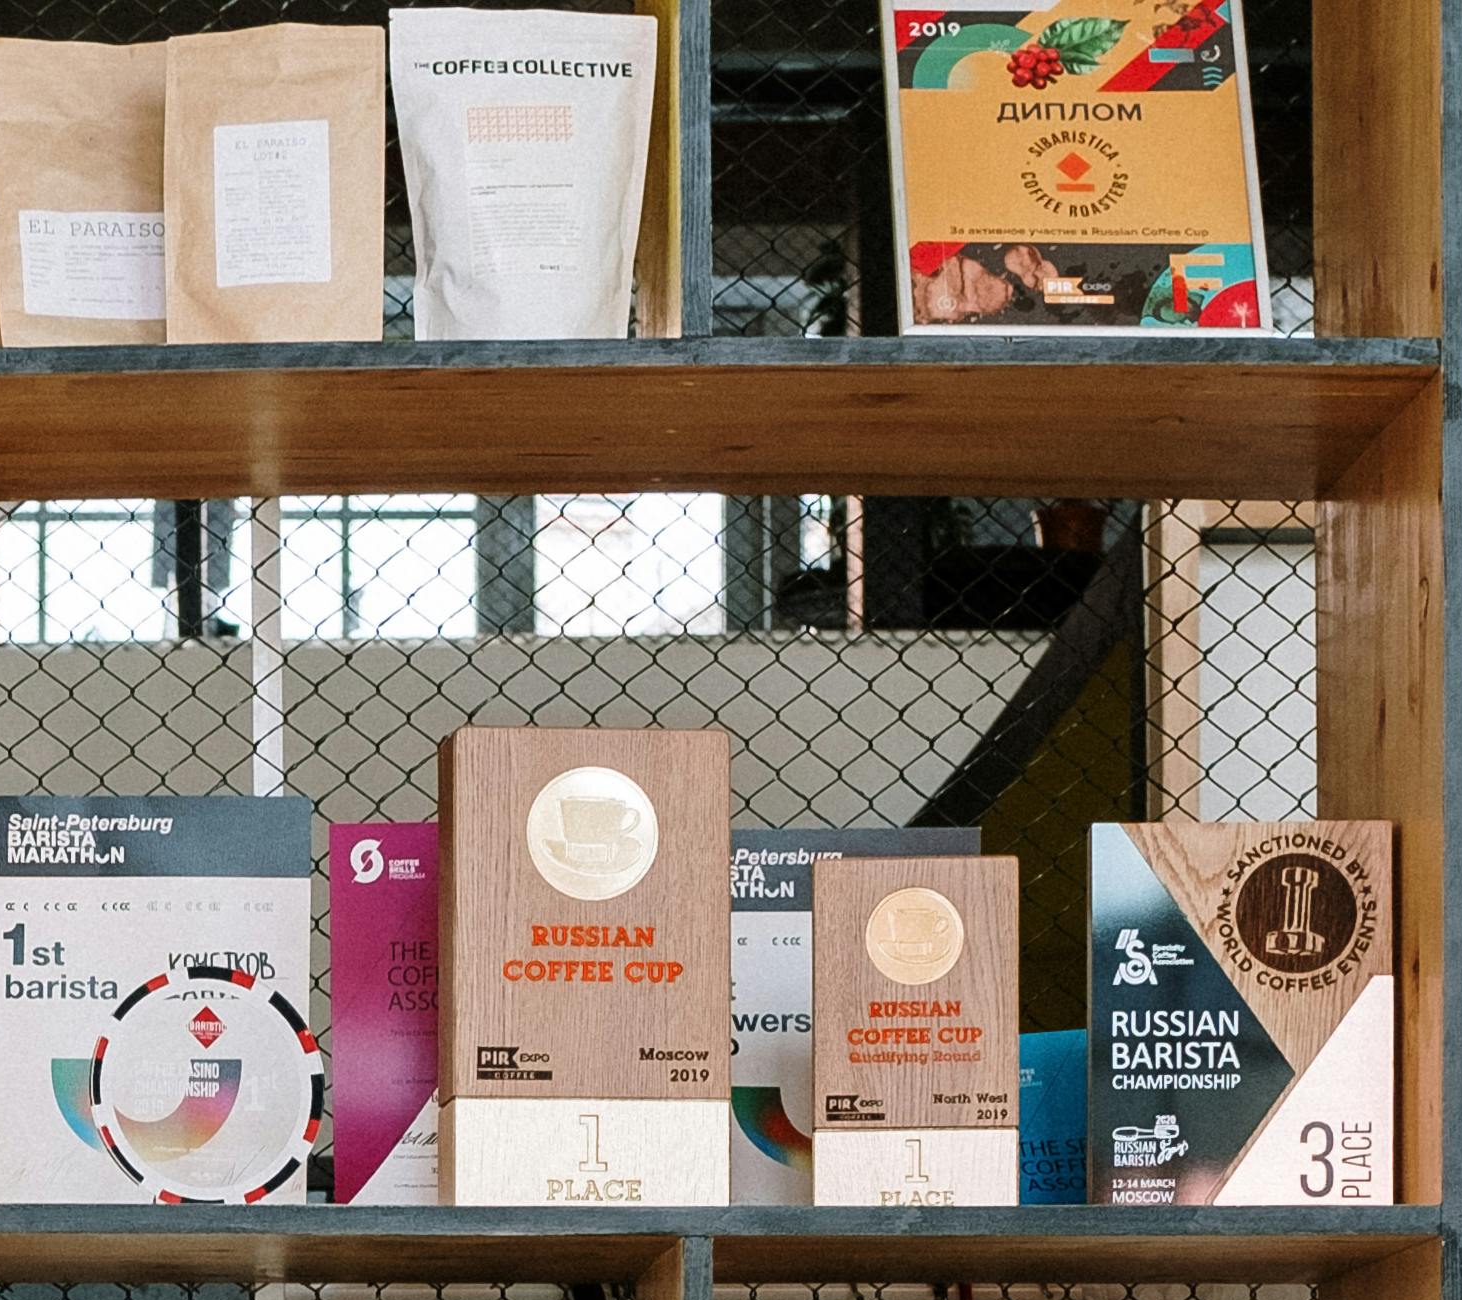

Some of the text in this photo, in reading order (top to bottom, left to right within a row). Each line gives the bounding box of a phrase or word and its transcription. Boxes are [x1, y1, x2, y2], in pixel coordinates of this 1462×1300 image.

[908, 22, 961, 36] 2019
[513, 60, 632, 78] COLLECTIVE
[996, 102, 1142, 122] ДИПЛОМ
[1027, 131, 1119, 163] SIBARISTICA
[28, 219, 165, 237] EL PARAISO
[1092, 228, 1181, 237] Russian Coffee
[8, 813, 173, 835] Saint-Petersburg
[8, 830, 96, 847] BARISTA
[1228, 832, 1368, 883] SANCTIONED BY
[3, 923, 65, 966] 1st
[532, 925, 655, 947] RUSSIAN
[390, 941, 428, 961] THE
[1217, 900, 1377, 993] WORLD COFFEE EVENTS
[503, 961, 683, 983] COFFEE CUP
[5, 975, 118, 1000] barista
[869, 1001, 960, 1017] RUSSIAN
[1112, 1011, 1239, 1037] RUSSIAN
[848, 1027, 982, 1044] COFFEE CUP
[481, 1051, 550, 1065] PIR EXPO
[639, 1048, 708, 1061] Moscow
[849, 1050, 981, 1066] Qualifying Round
[1112, 1042, 1240, 1069] BARISTA
[670, 1069, 709, 1082] 2019
[1112, 1074, 1241, 1090] CHAMPIONSHIP
[933, 1093, 1008, 1104] North West
[977, 1109, 1008, 1120] 2019
[1155, 1116, 1176, 1124] 2020
[579, 1115, 608, 1172] 1
[1114, 1141, 1156, 1154] RUSSIAN
[905, 1139, 929, 1183] 1
[1114, 1154, 1157, 1167] BARISTA
[1300, 1122, 1334, 1197] 3
[1341, 1121, 1372, 1198] PLACE
[546, 1179, 641, 1200] PLACE
[1141, 1179, 1175, 1187] MARCH
[881, 1190, 954, 1206] PLACE
[1112, 1190, 1174, 1204] MOSCOW
